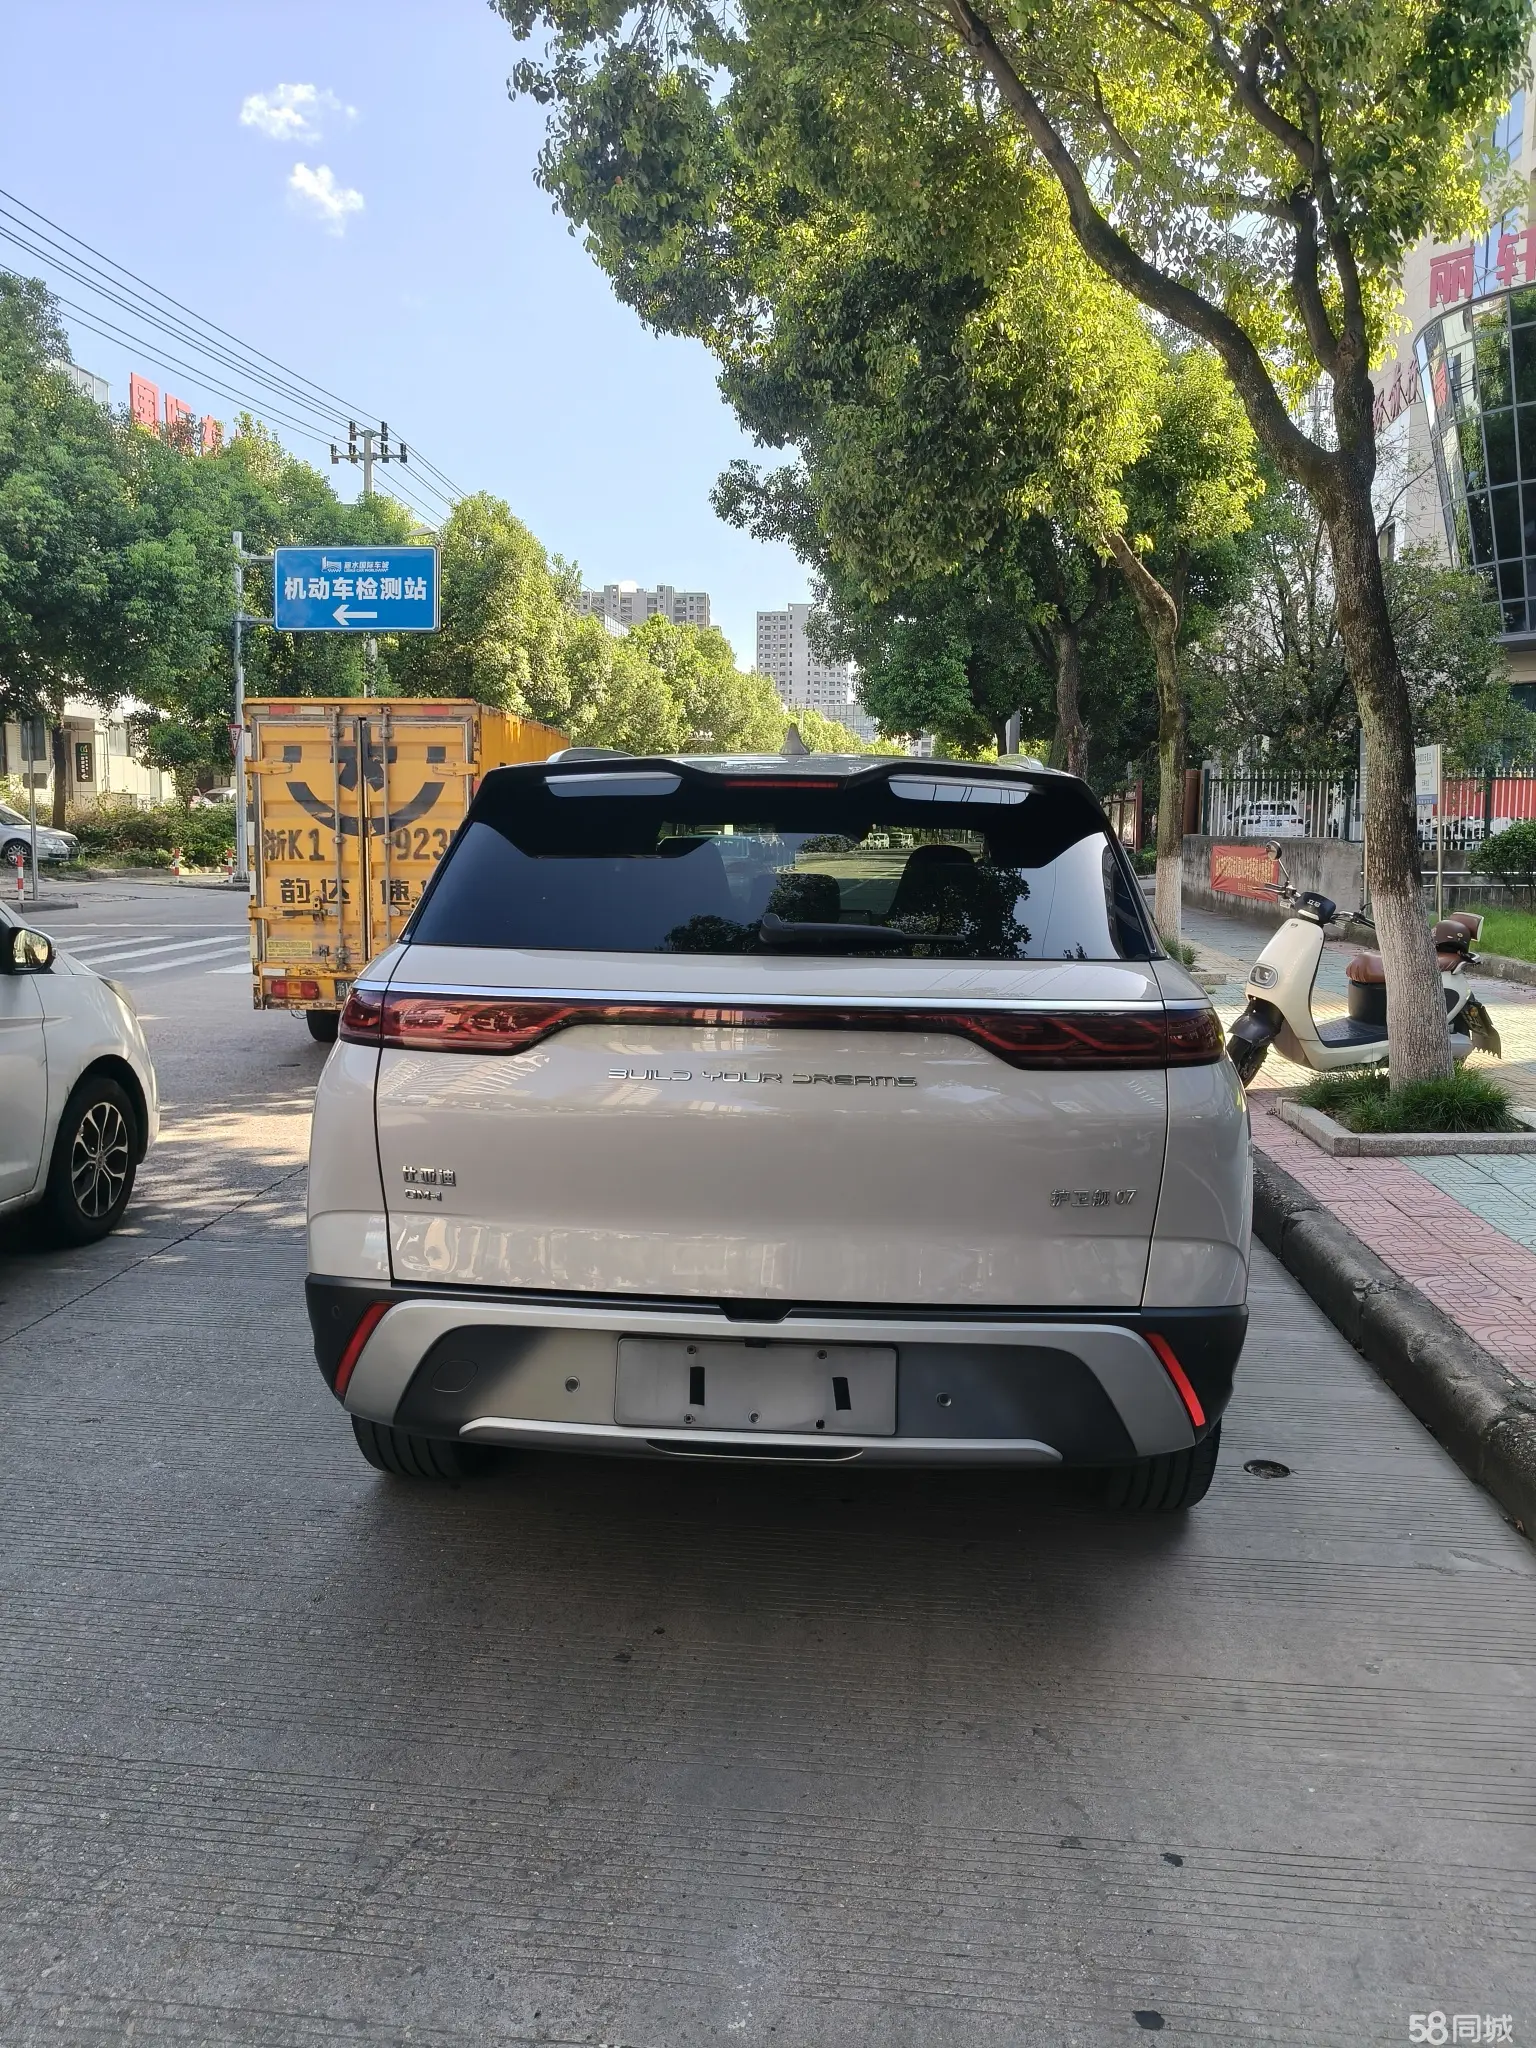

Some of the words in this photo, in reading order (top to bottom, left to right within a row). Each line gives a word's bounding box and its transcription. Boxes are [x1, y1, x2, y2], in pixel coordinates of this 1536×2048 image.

[1429, 226, 1536, 308] 丽轩
[284, 576, 427, 600] 机动车检测站
[608, 1068, 693, 1081] BUILD
[701, 1070, 783, 1084] YOUR
[791, 1073, 917, 1087] DREAMS
[402, 1165, 456, 1186] 比亚迪
[1115, 1188, 1137, 1205] 07
